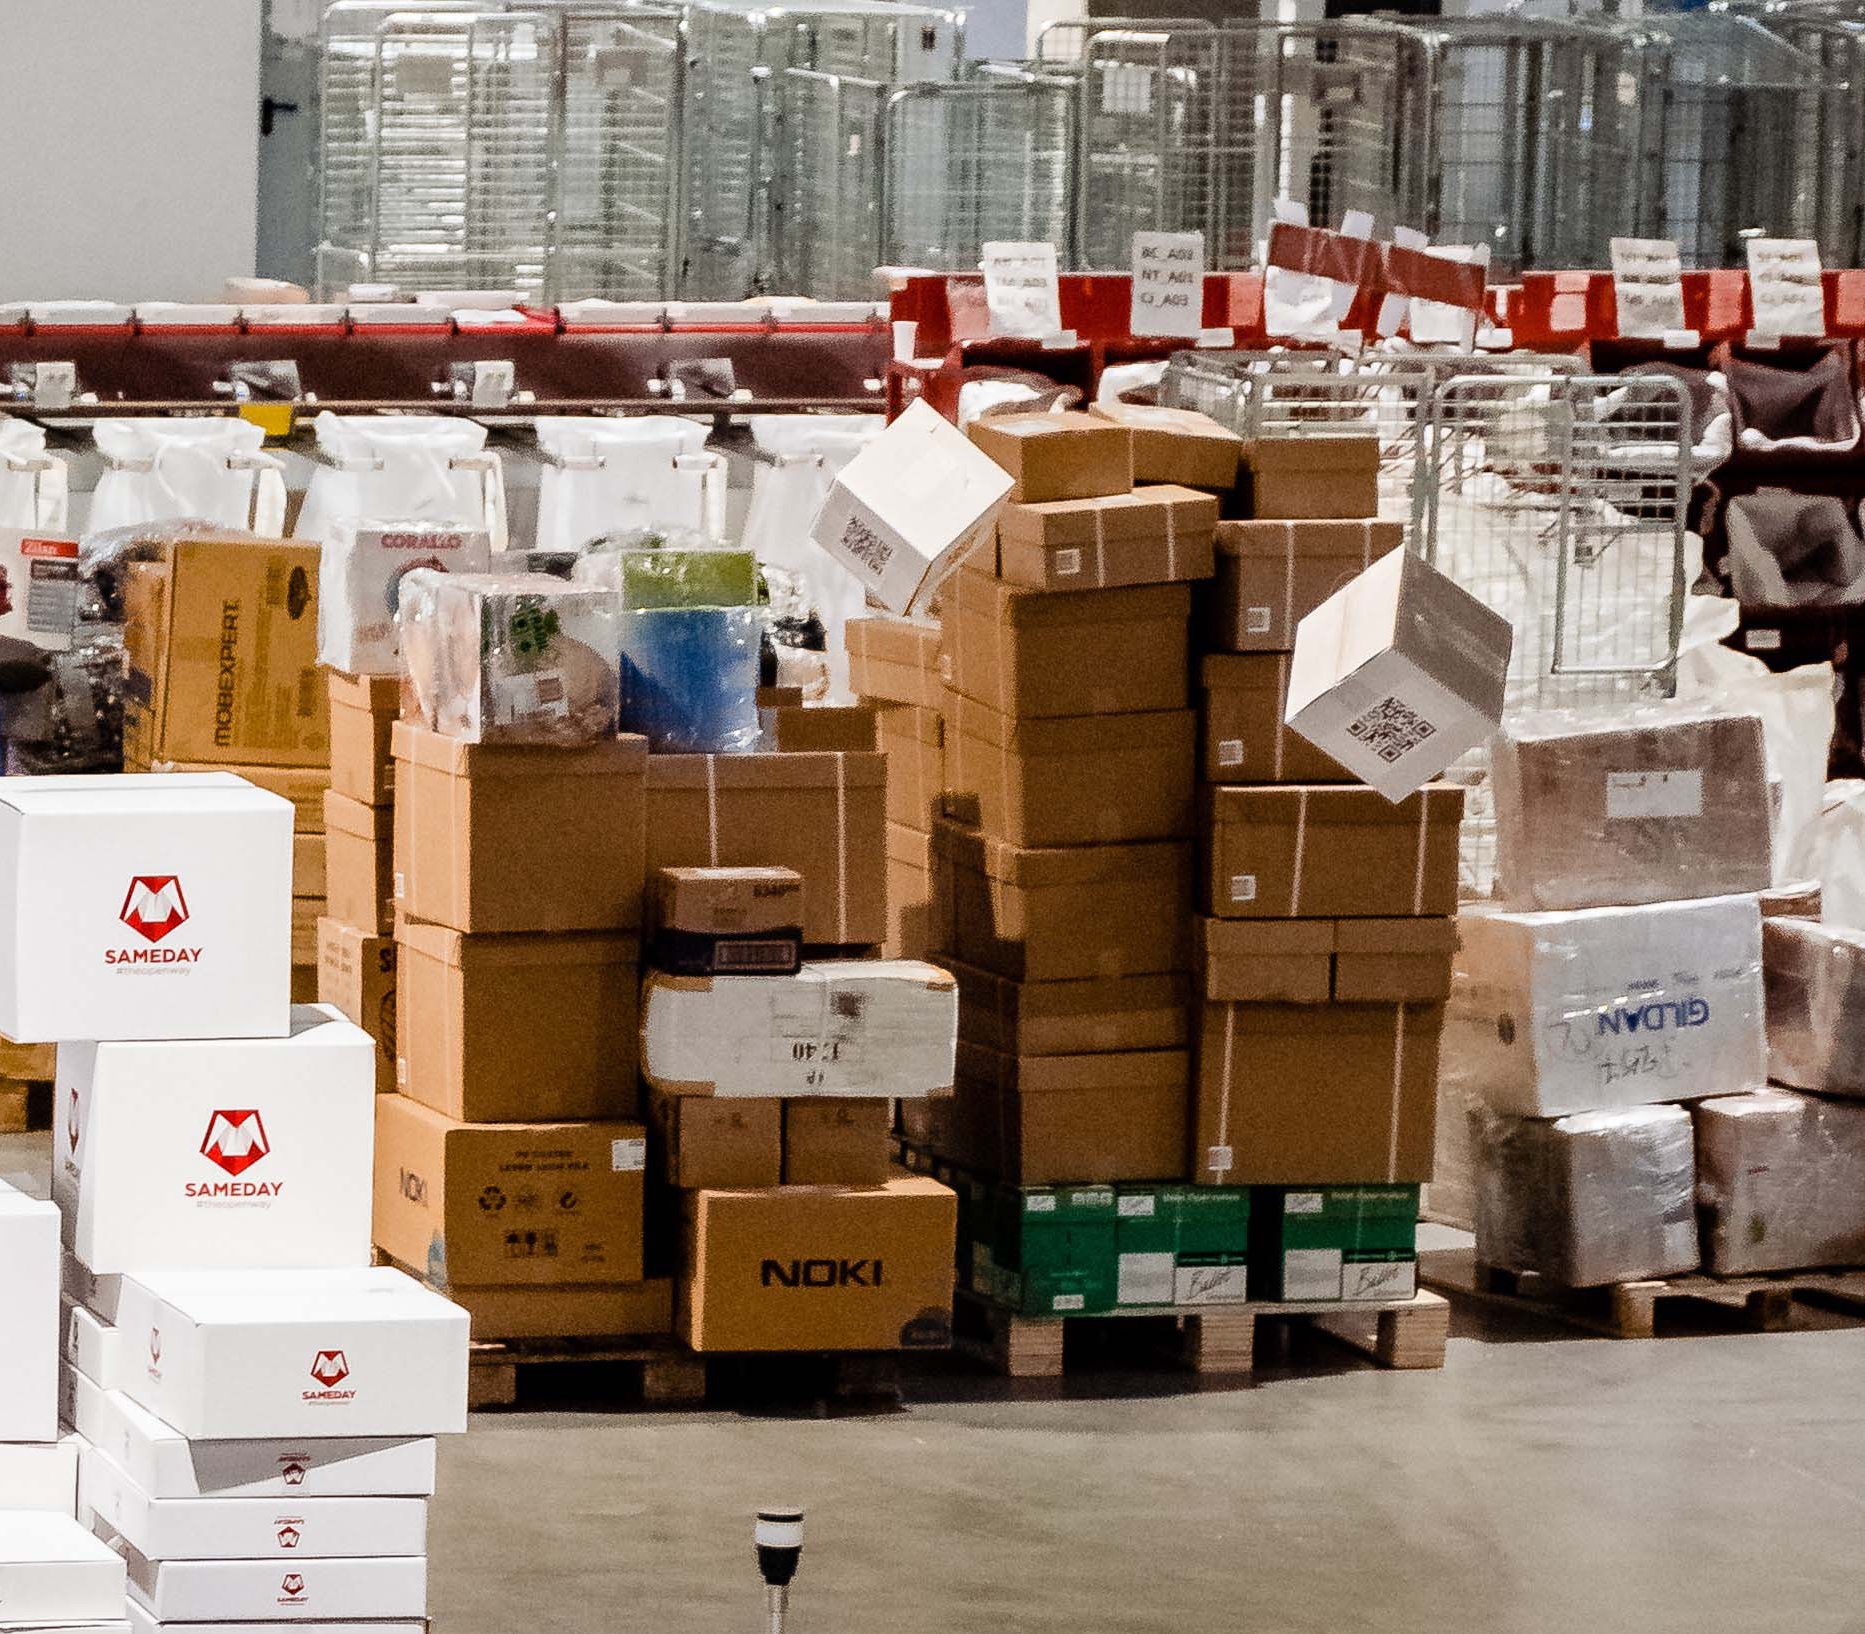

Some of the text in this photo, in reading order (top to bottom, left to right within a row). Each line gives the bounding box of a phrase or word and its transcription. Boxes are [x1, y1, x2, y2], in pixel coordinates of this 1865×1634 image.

[215, 600, 241, 747] MOBEXPERT
[105, 948, 203, 964] SAMEDAY
[1598, 996, 1712, 1035] GILDAN
[185, 1182, 283, 1197] SAMEDAY
[761, 1259, 883, 1287] NOKI
[302, 1390, 356, 1401] SAMEDAY
